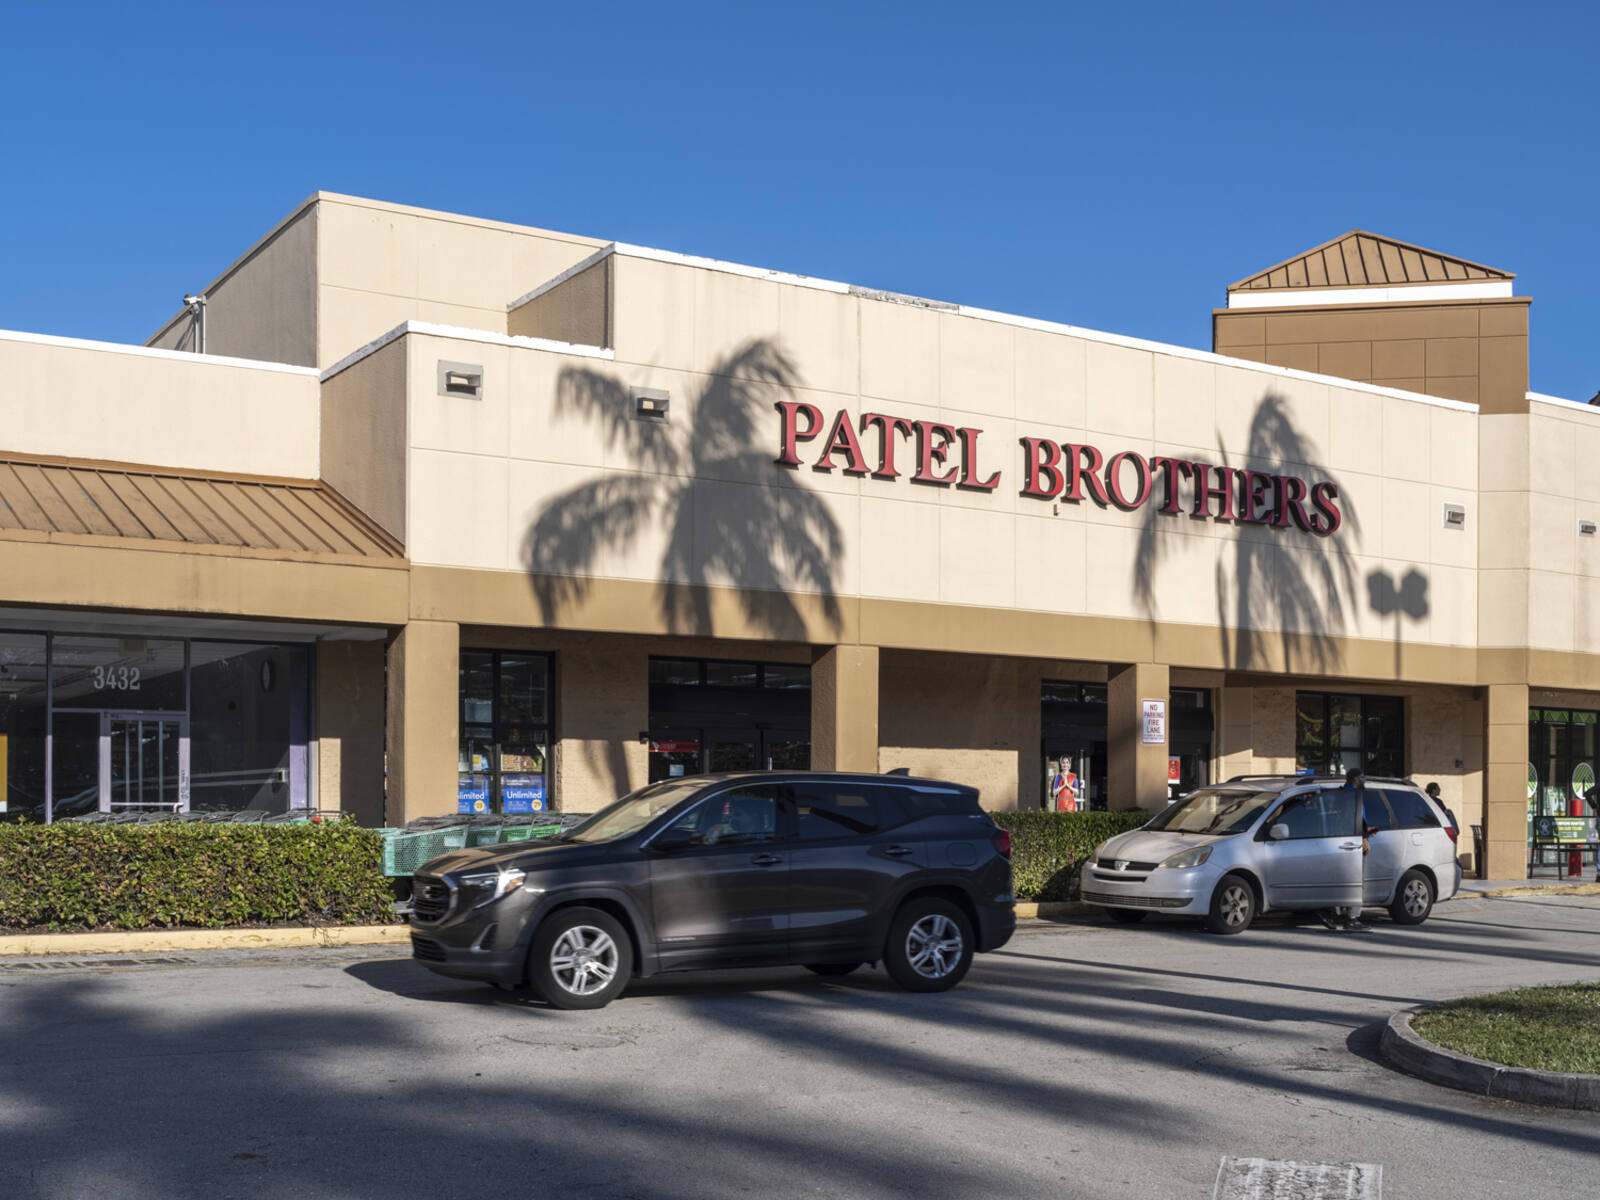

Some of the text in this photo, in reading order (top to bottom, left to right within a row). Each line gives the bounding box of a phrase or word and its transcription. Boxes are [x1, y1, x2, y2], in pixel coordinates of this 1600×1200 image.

[774, 401, 1341, 536] PATEL BROTHERS
[93, 665, 141, 690] 3432
[458, 791, 485, 800] limited
[506, 791, 542, 799] Unlimited
